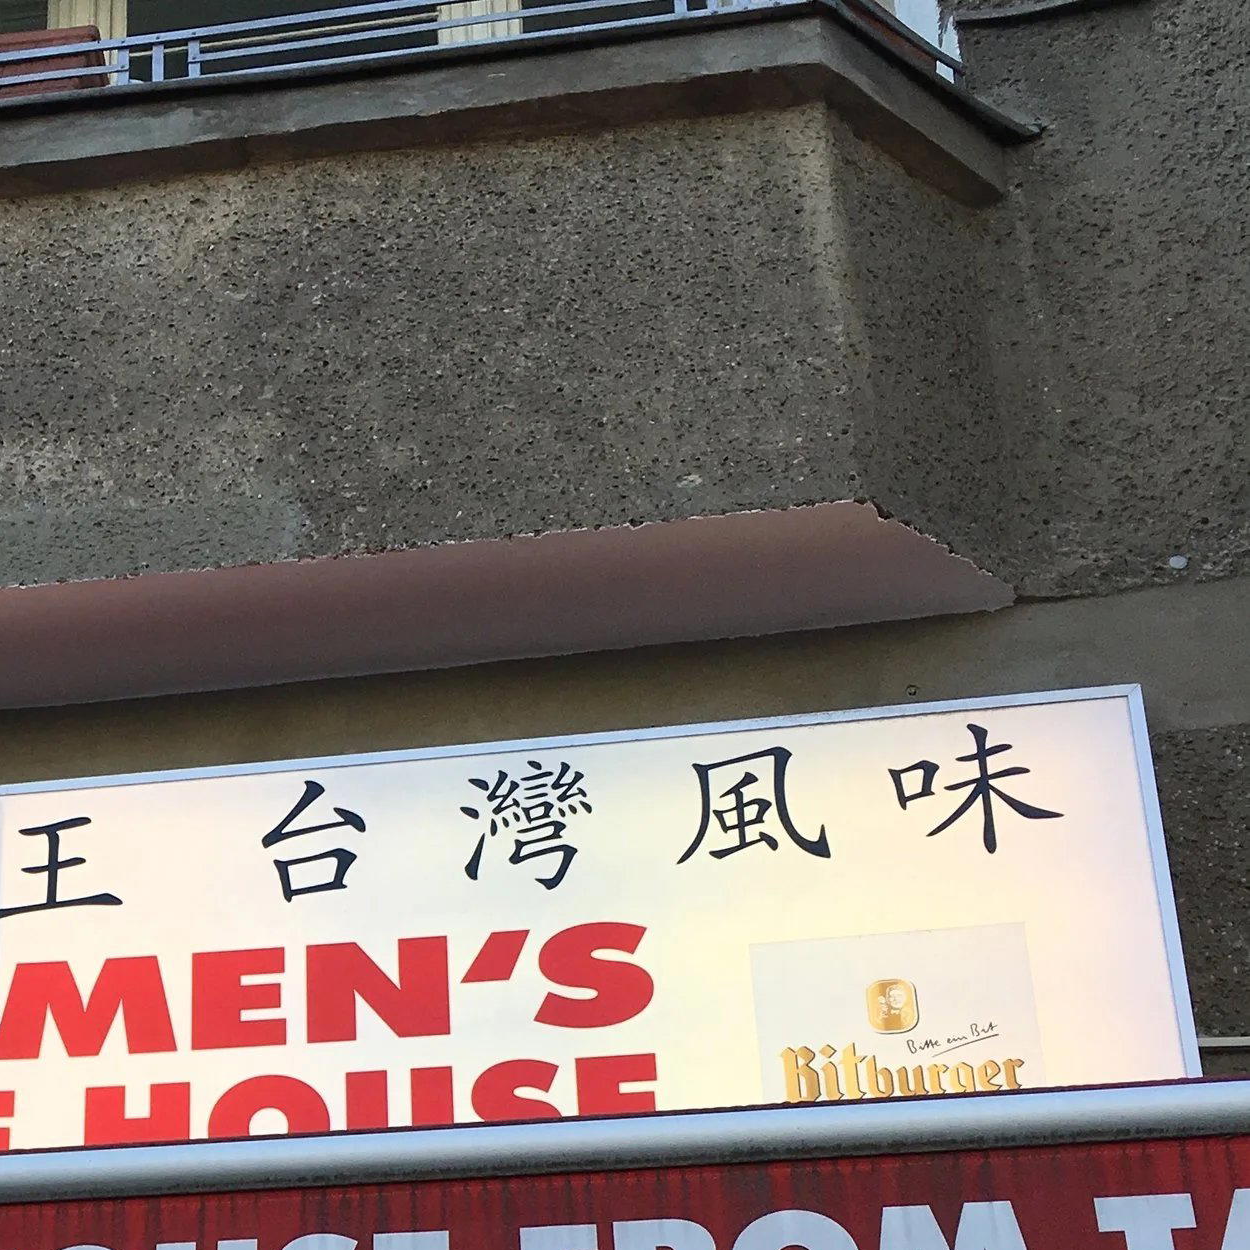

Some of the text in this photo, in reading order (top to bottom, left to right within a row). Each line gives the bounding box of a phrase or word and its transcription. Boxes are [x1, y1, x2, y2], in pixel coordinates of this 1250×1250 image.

[260, 723, 1064, 903] 台灣風味
[781, 1042, 1025, 1104] Bitburger
